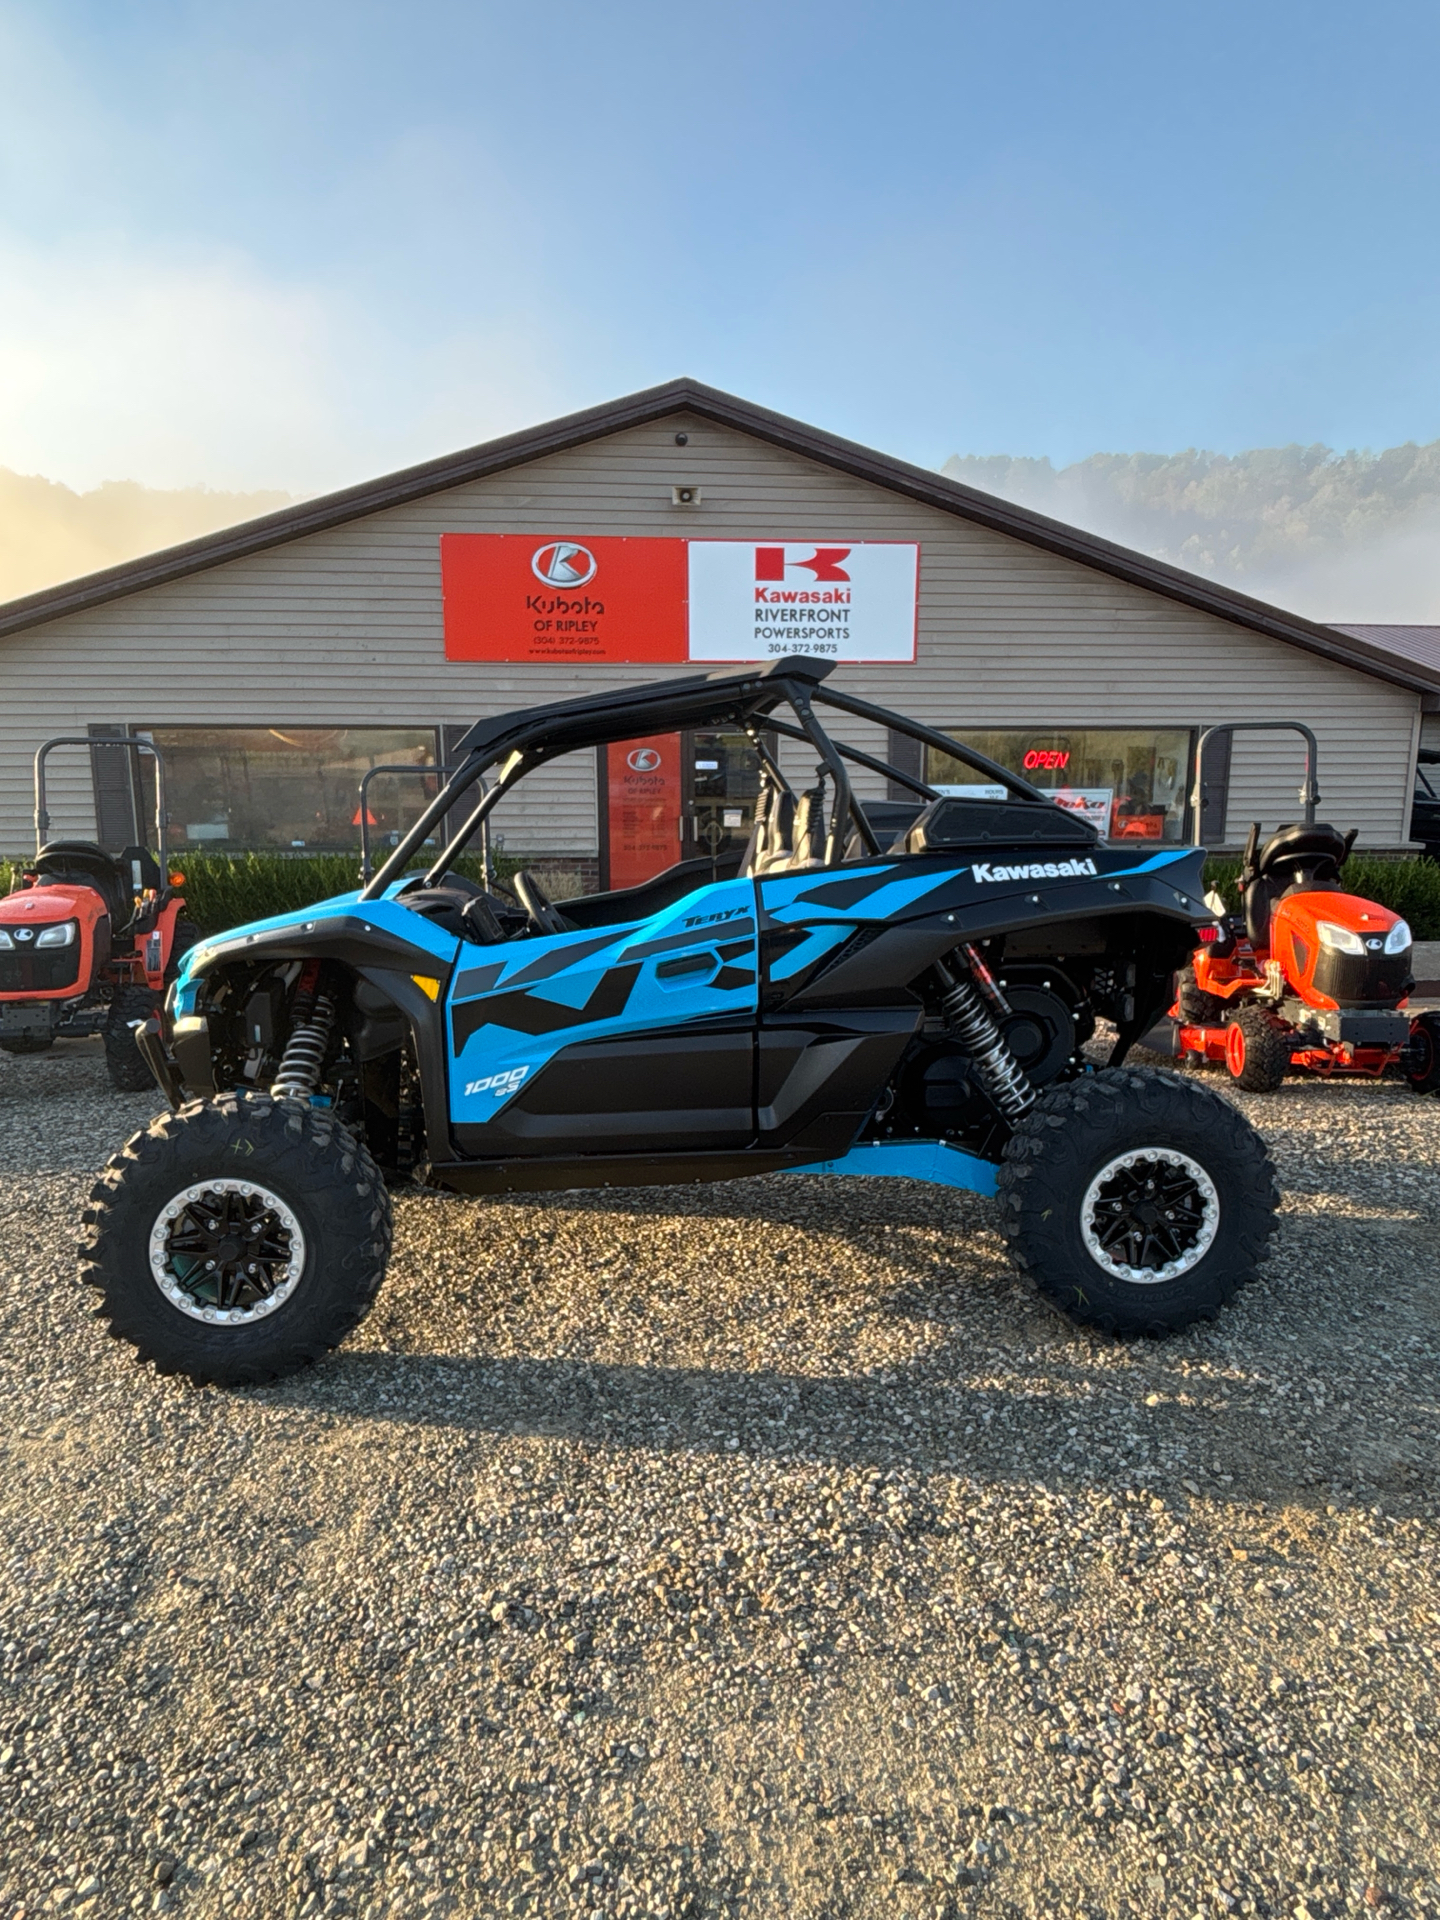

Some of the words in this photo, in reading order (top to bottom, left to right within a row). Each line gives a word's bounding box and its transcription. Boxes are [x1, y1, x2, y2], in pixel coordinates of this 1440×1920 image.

[754, 587, 851, 604] Kawasaki
[526, 595, 605, 614] Kubota
[754, 608, 851, 622] RIVERFRONT
[533, 619, 553, 631] OF
[556, 620, 598, 632] RIPLEY
[754, 627, 850, 639] POWERSPORTS
[533, 636, 555, 645] (304)
[559, 636, 599, 645] 372-9875
[768, 643, 838, 653] 304-372-9875
[1023, 749, 1070, 769] OPEN
[971, 858, 1097, 883] Kawasaki
[464, 1065, 530, 1097] 1000
